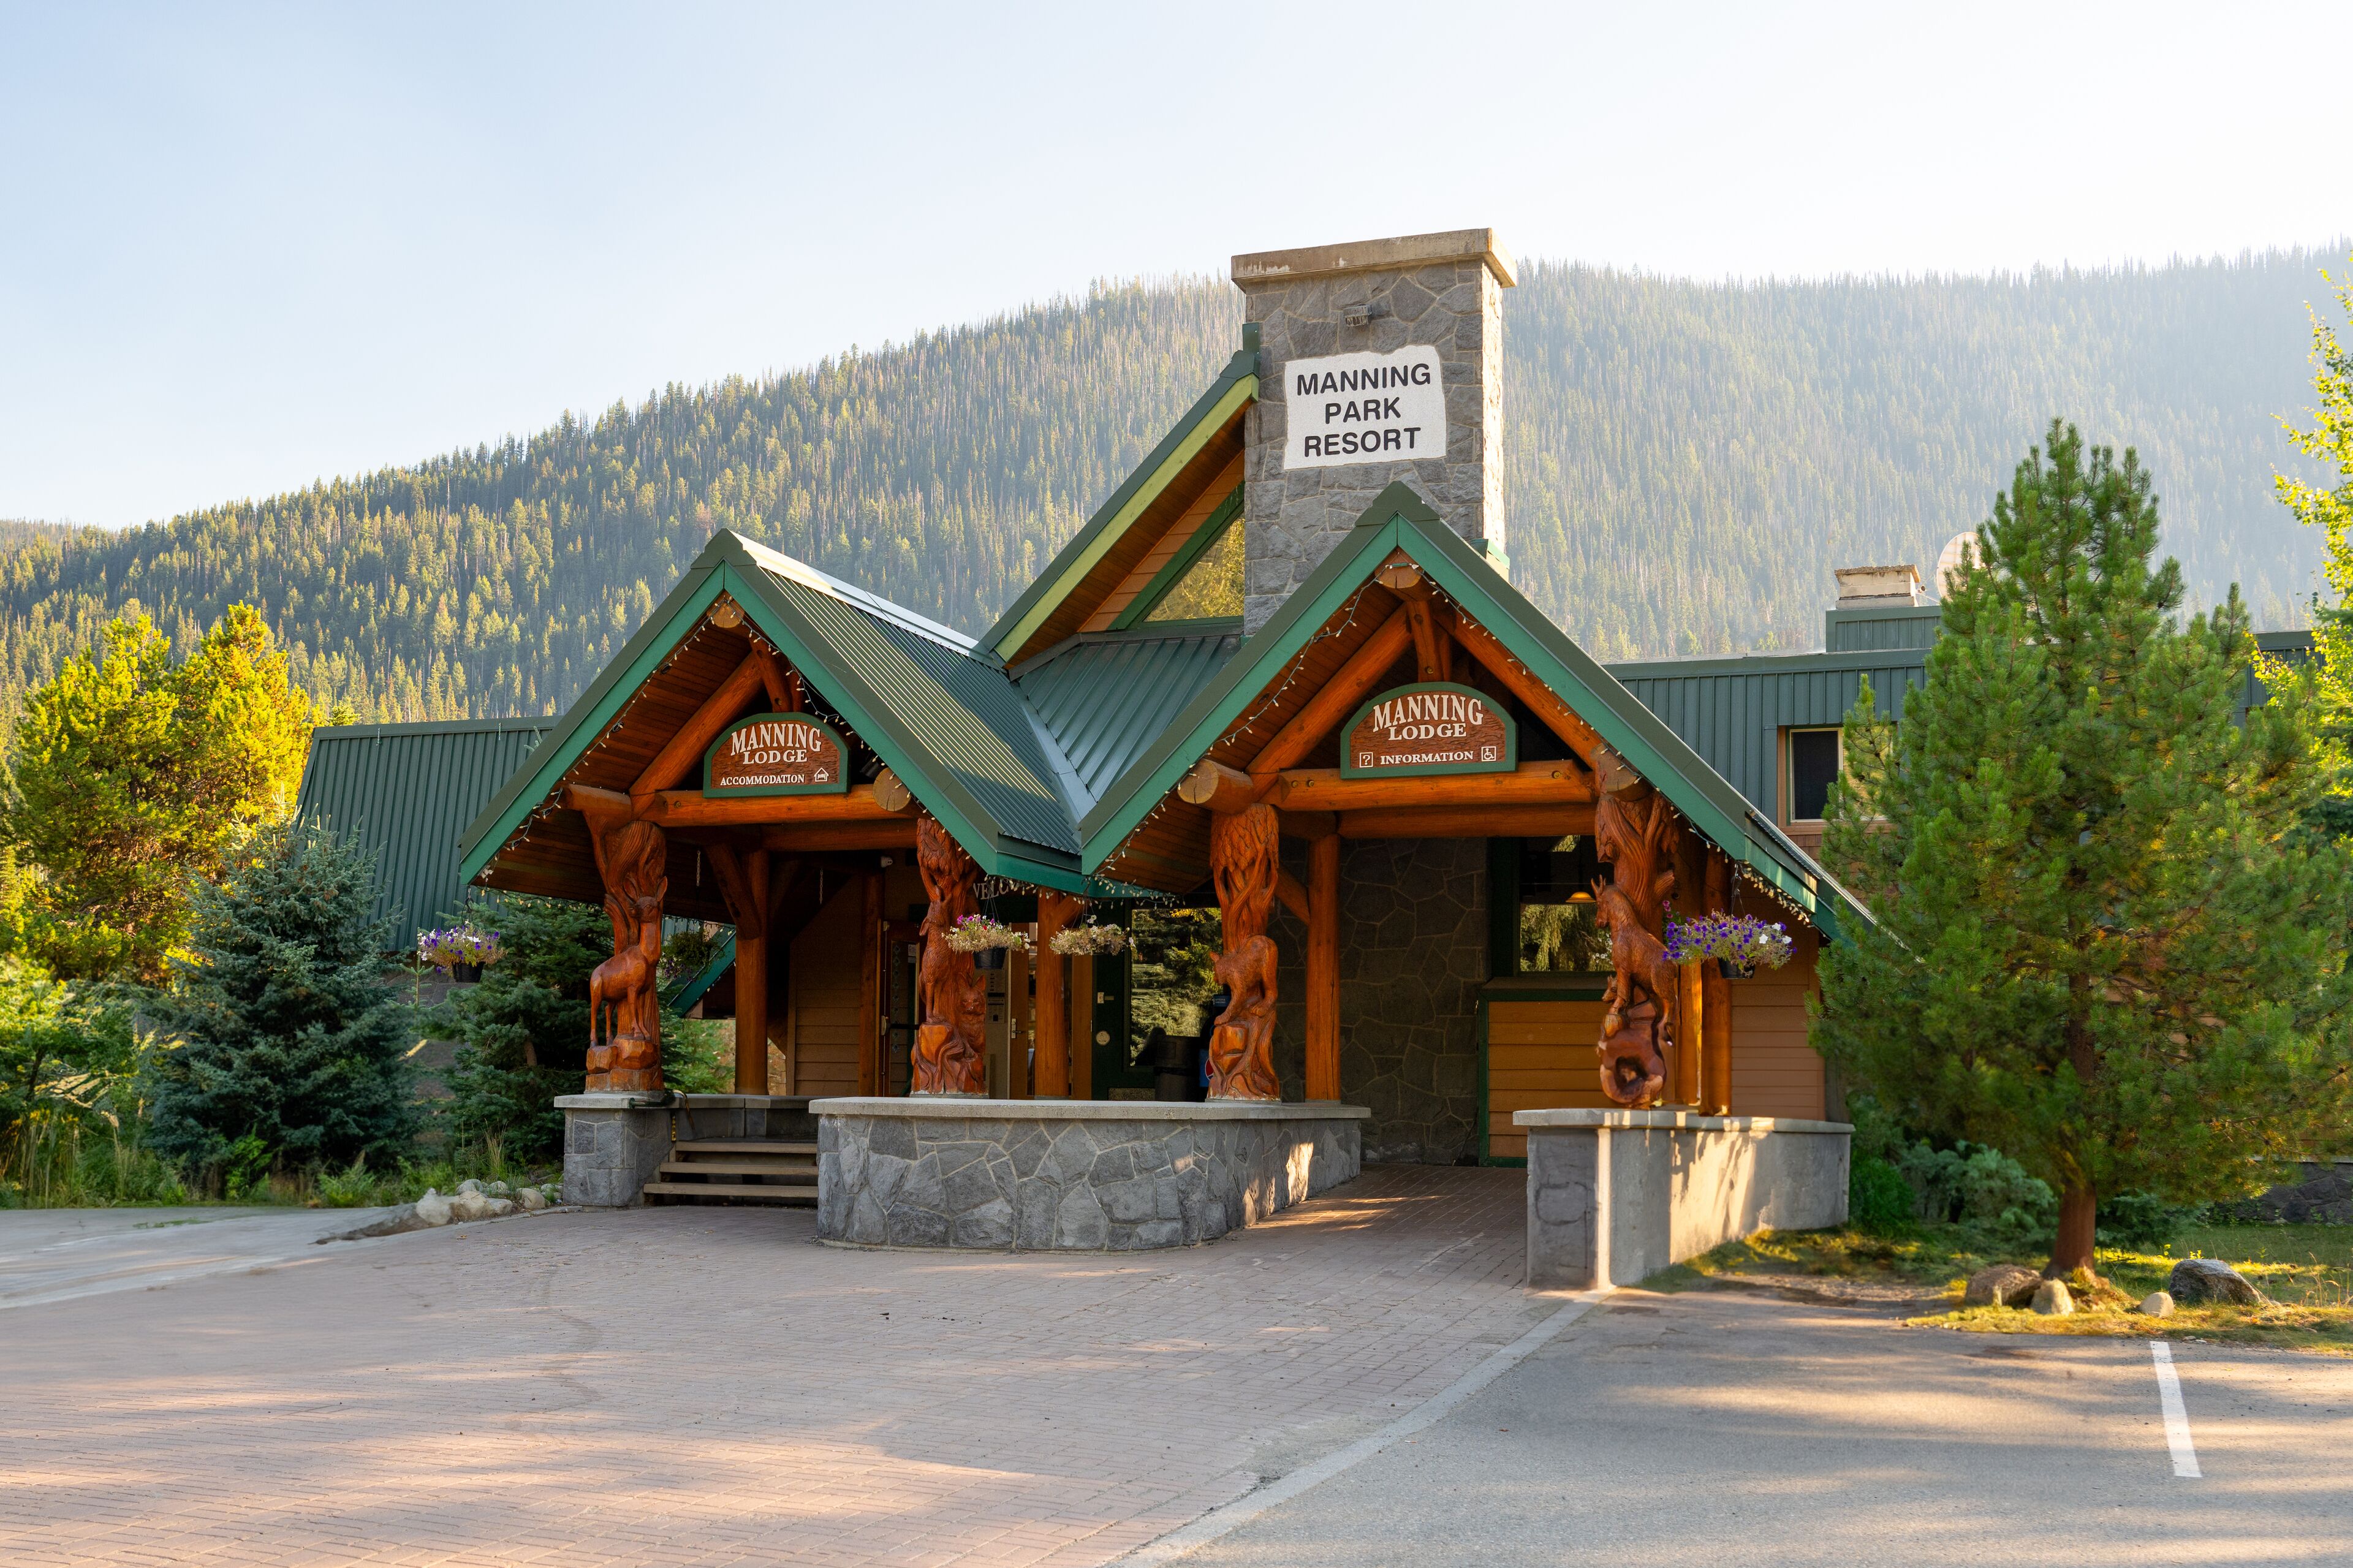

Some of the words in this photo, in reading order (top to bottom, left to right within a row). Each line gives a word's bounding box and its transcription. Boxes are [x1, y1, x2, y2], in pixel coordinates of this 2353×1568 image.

[1297, 363, 1431, 396] MANNING
[1325, 397, 1401, 424] PARK
[1305, 427, 1421, 457] RESORT
[1373, 694, 1483, 732] MANNING
[730, 724, 822, 756] MANNING
[1388, 723, 1466, 741] LODGE
[743, 749, 808, 764] LODGE
[1380, 751, 1474, 765] INFORMATION
[720, 775, 805, 786] ACCOMMODATION
